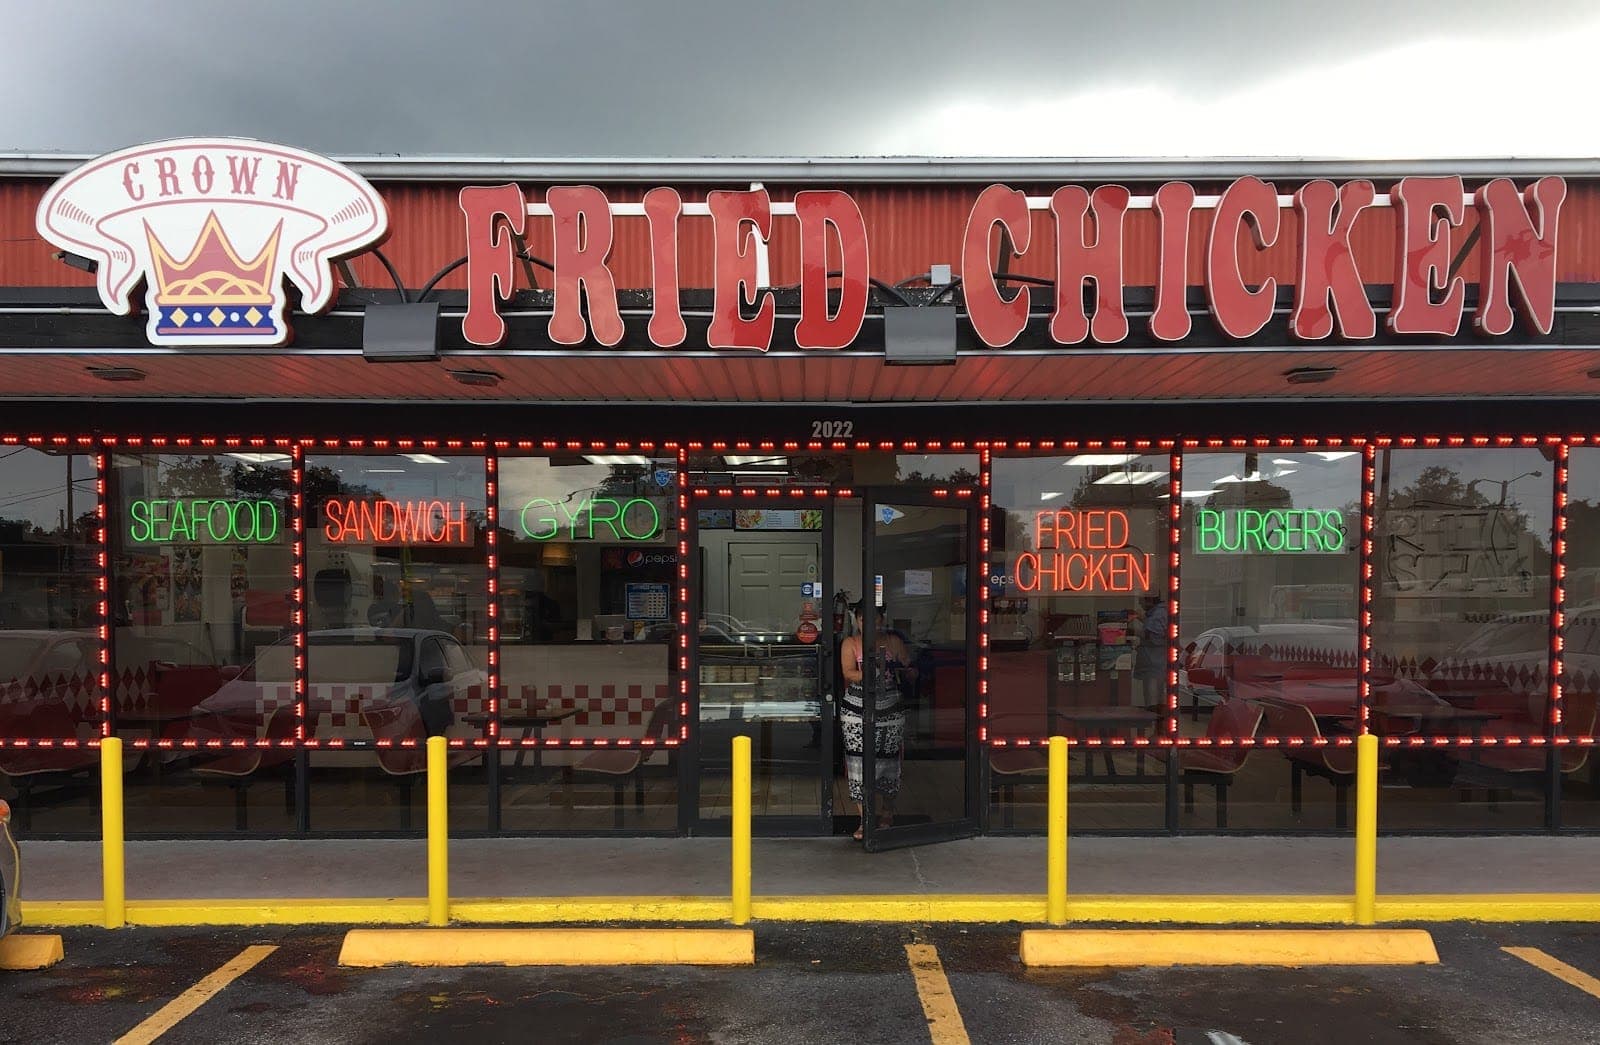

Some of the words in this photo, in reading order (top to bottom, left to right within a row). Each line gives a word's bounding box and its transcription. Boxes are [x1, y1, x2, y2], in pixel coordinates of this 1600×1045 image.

[123, 154, 302, 201] CROWN
[459, 183, 870, 352] FRIED
[961, 175, 1567, 349] CHICKEN
[811, 420, 853, 439] 2022
[130, 499, 278, 542] SEAFOOD
[325, 499, 465, 543] SANDWICH
[520, 497, 659, 540] GYRO
[1035, 510, 1129, 550] FRIED
[1199, 509, 1345, 552] BURGERS
[990, 575, 1015, 587] eps
[1014, 552, 1150, 592] CHICKEN
